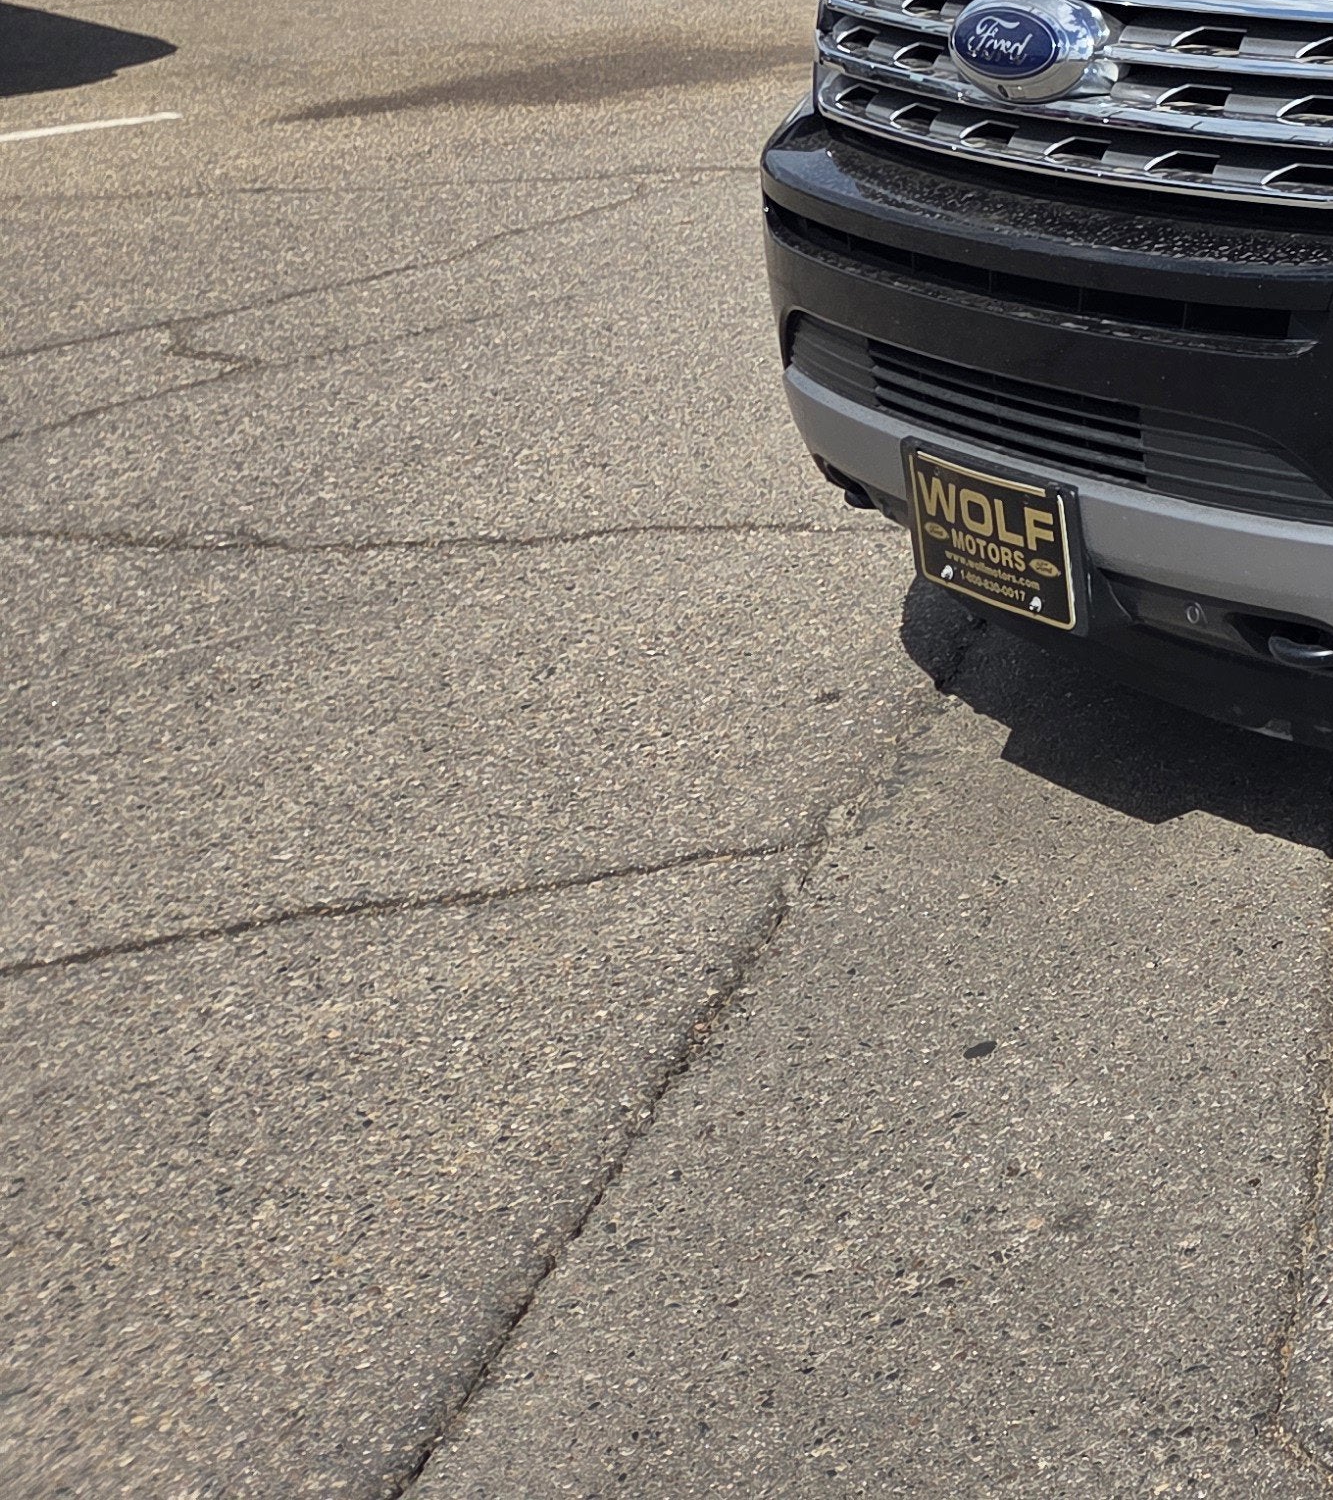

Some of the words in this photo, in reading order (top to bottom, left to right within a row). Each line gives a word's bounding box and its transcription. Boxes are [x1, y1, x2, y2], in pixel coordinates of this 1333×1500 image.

[966, 15, 1034, 64] Ford
[917, 471, 1054, 550] WOLF
[951, 528, 1027, 572] MOTORS
